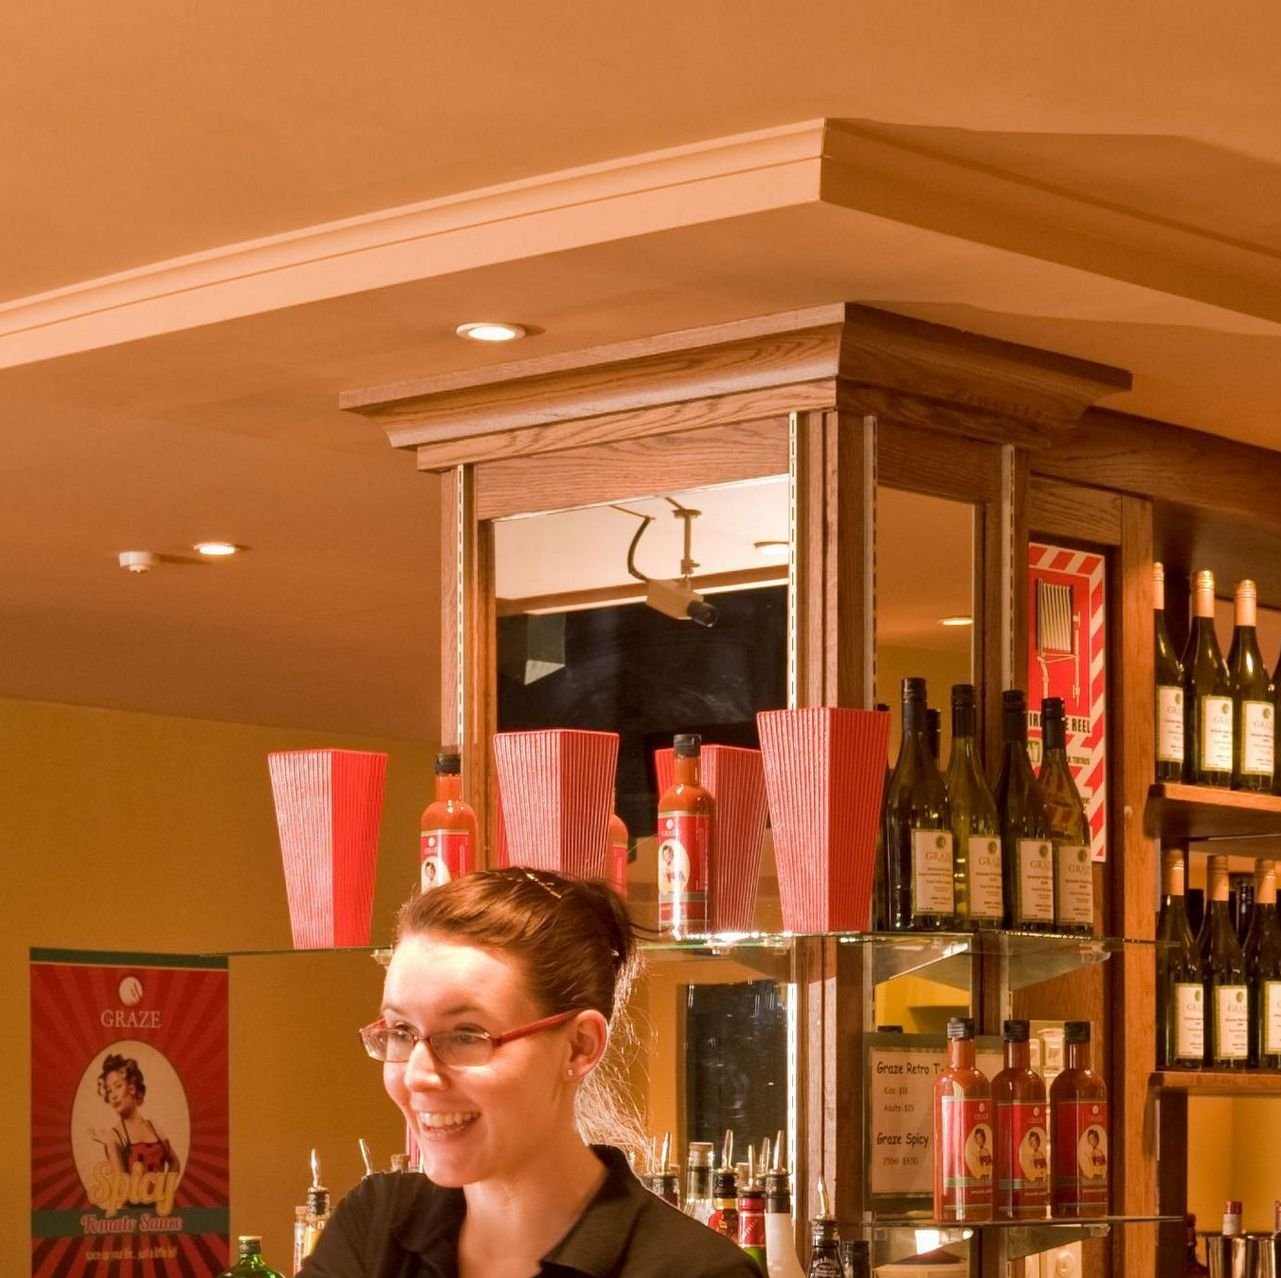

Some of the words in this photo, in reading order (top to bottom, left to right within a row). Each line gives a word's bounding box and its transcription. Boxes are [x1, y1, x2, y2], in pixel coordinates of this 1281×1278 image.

[1072, 718, 1091, 734] REEL
[100, 1010, 161, 1029] GRAZE
[877, 1061, 903, 1074] Graze
[906, 1061, 930, 1075] Retro
[877, 1132, 902, 1145] Graze
[906, 1132, 929, 1149] Spicy
[89, 1161, 178, 1217] Spicy
